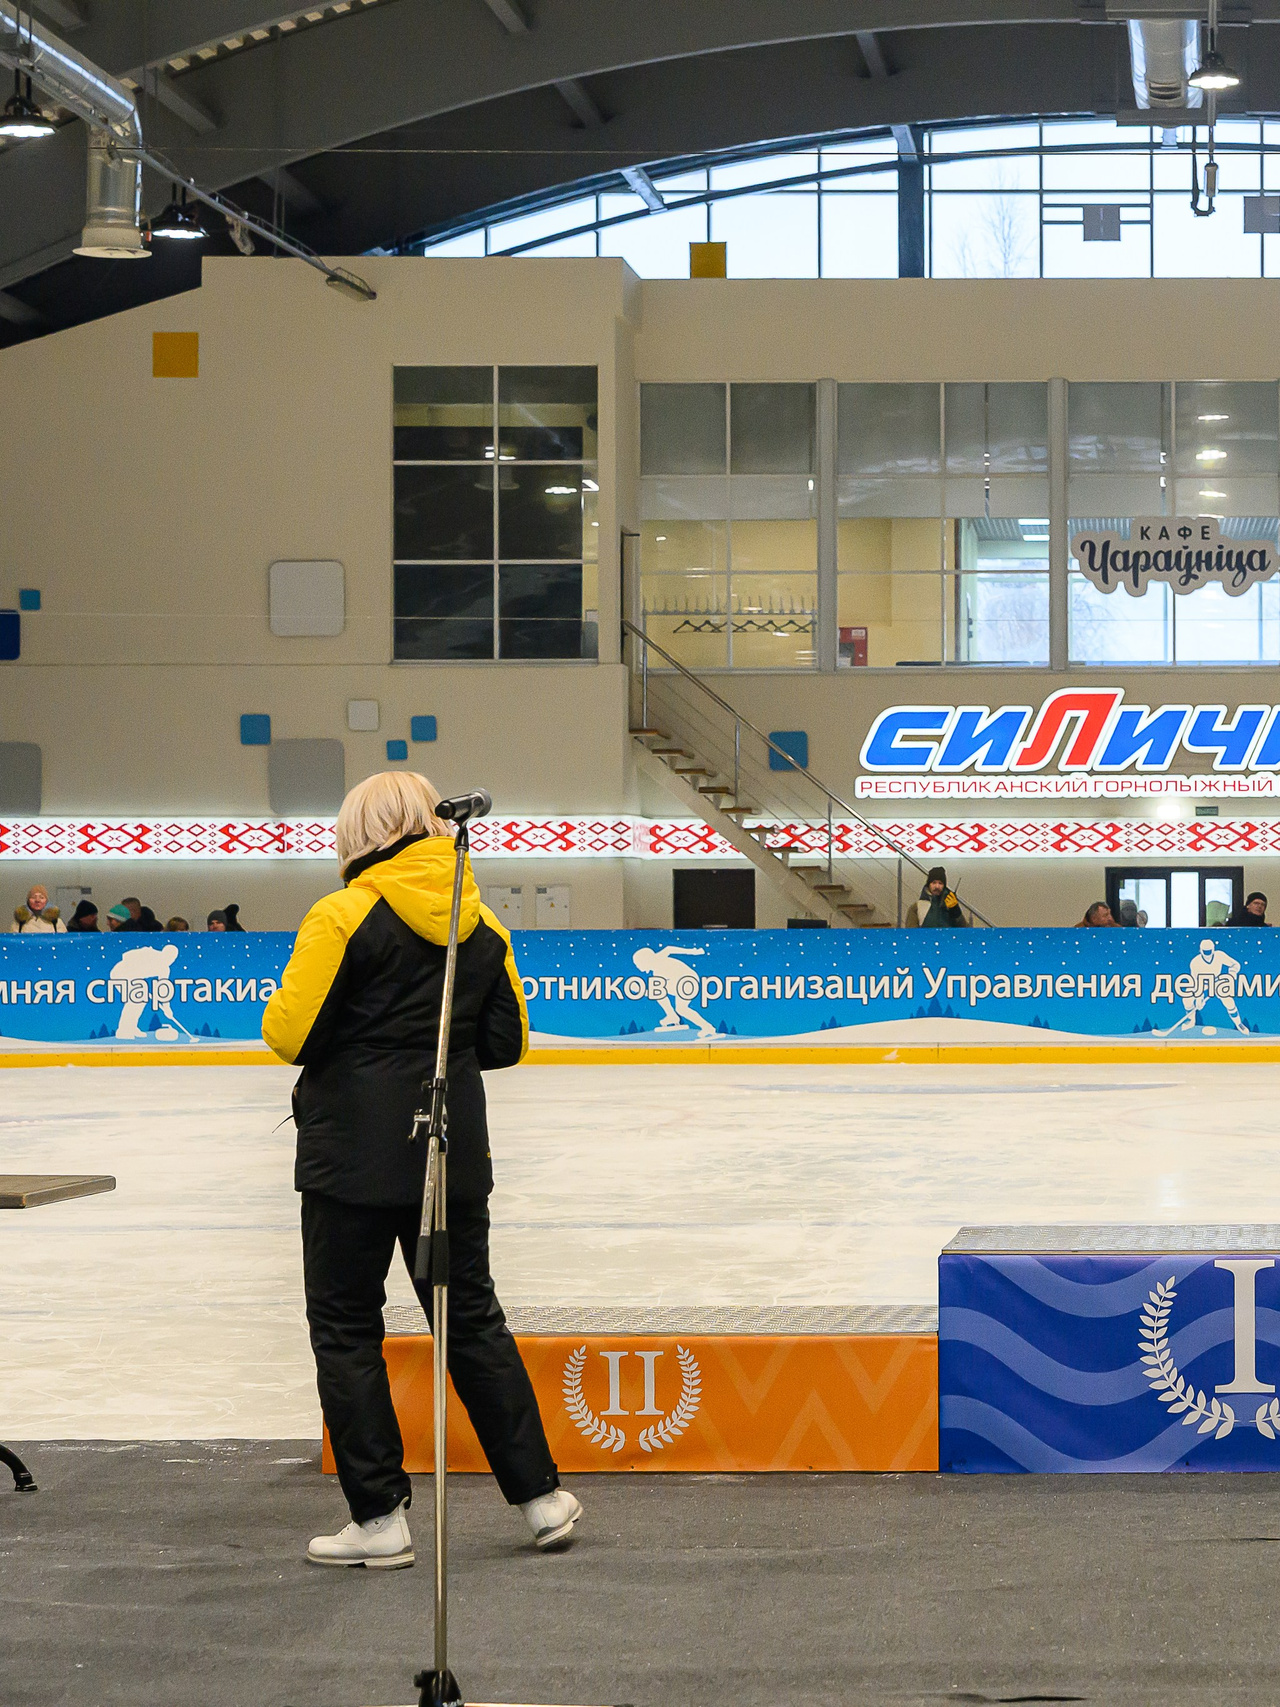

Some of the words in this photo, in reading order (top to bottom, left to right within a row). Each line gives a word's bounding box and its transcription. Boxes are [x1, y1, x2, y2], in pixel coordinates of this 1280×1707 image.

[1140, 525, 1211, 540] КАФЕ
[1080, 540, 1271, 589] Чараўніца
[860, 778, 1088, 793] РЕСПУБЛИКАНСКИЙ
[1093, 776, 1273, 793] ГОРНОЛЫЖНЫЙ
[86, 977, 278, 1010] спартакиа
[520, 975, 668, 1002] отников
[677, 967, 914, 1008] организаций
[922, 966, 1142, 1006] Управления
[1213, 1259, 1276, 1393] I
[598, 1351, 665, 1416] II
